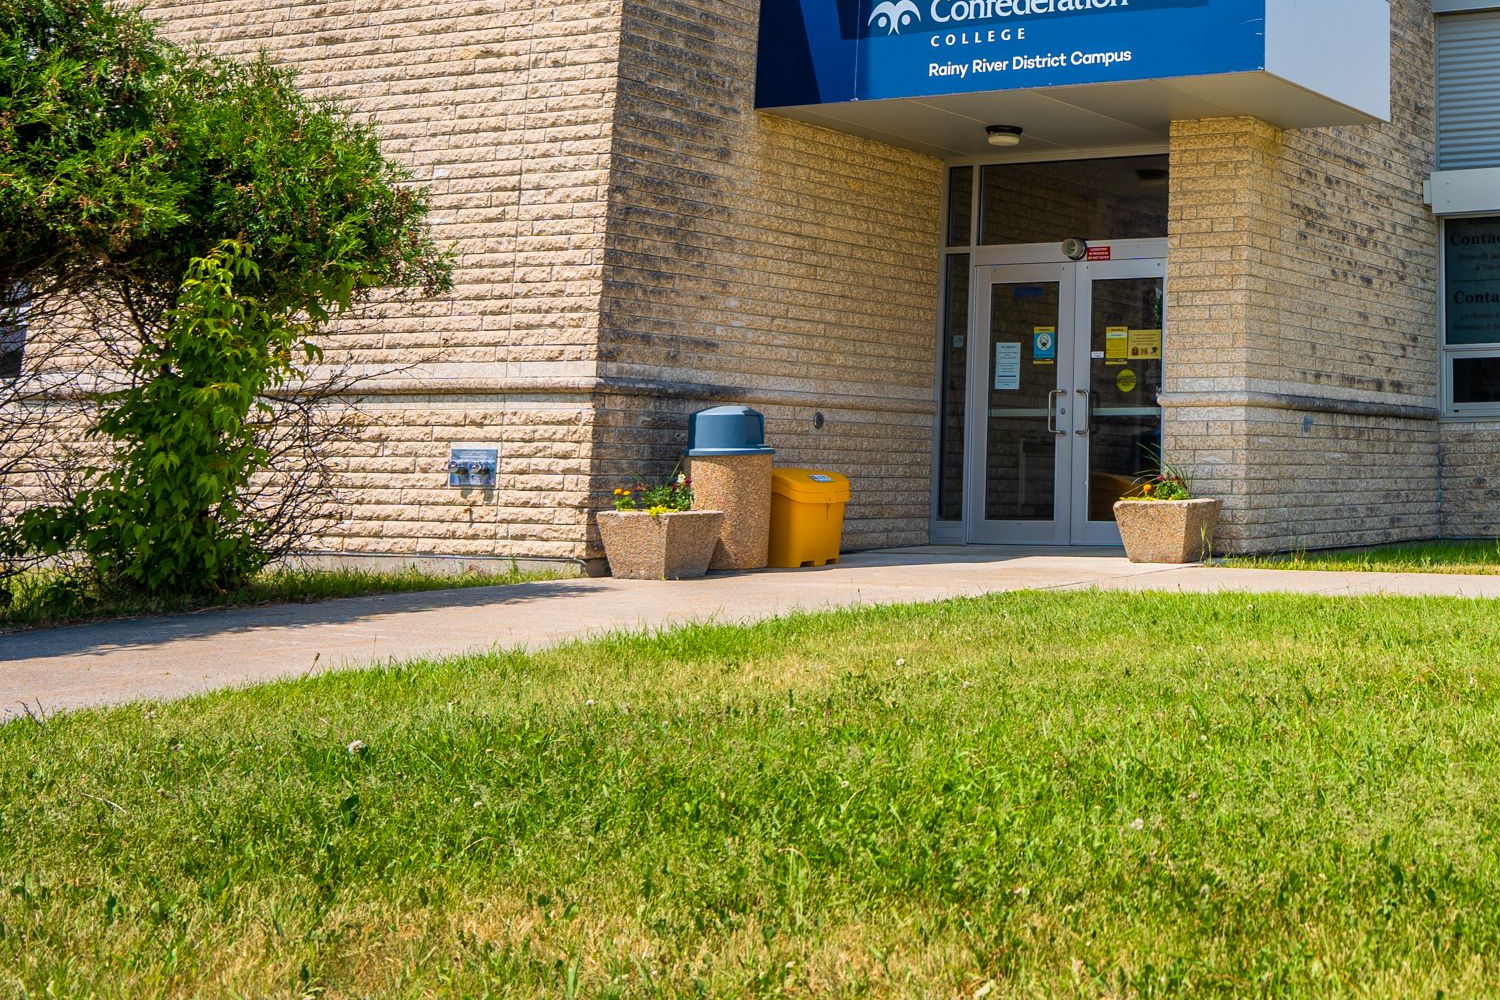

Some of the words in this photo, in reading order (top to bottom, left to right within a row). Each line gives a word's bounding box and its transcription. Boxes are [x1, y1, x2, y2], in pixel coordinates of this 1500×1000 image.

[930, 27, 1026, 47] COLLEGE
[928, 62, 969, 78] Rainy
[972, 57, 1010, 73] River
[1012, 52, 1067, 70] District
[1070, 48, 1132, 67] Campus
